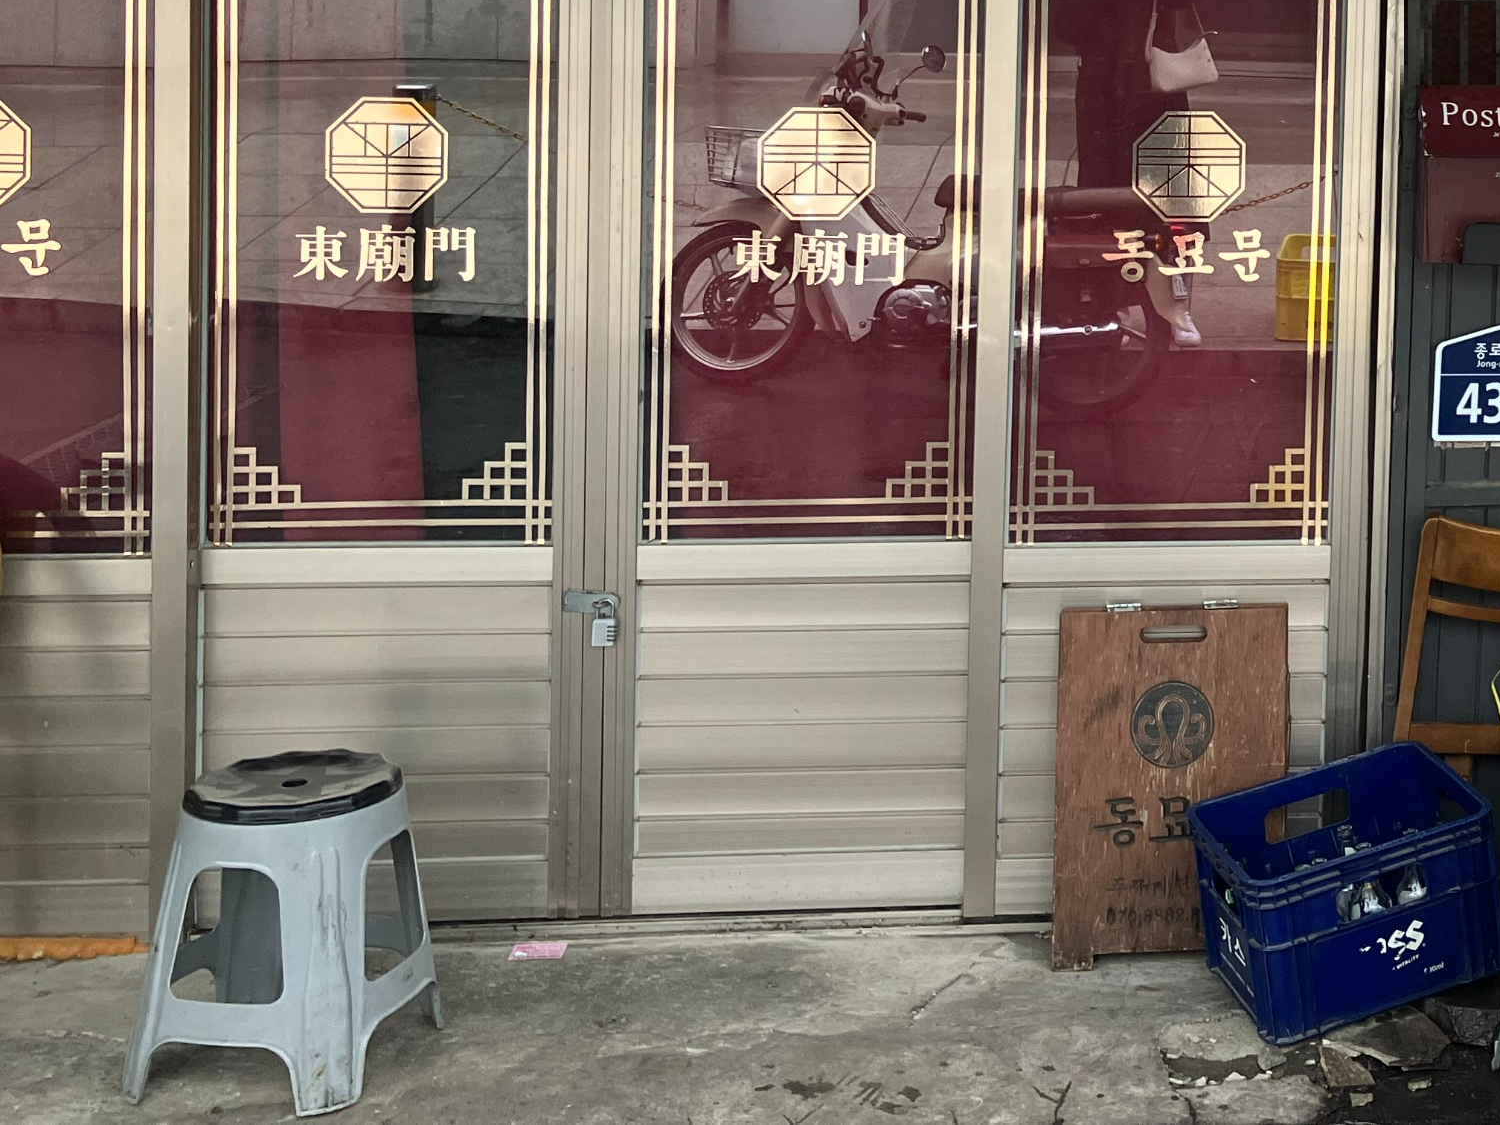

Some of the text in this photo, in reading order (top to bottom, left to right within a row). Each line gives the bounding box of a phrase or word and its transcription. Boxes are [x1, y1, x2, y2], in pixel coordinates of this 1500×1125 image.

[293, 226, 477, 283] 東廟門
[728, 230, 907, 287] 東廟門
[1101, 229, 1271, 283] 동묘문
[1219, 917, 1247, 967] 카스
